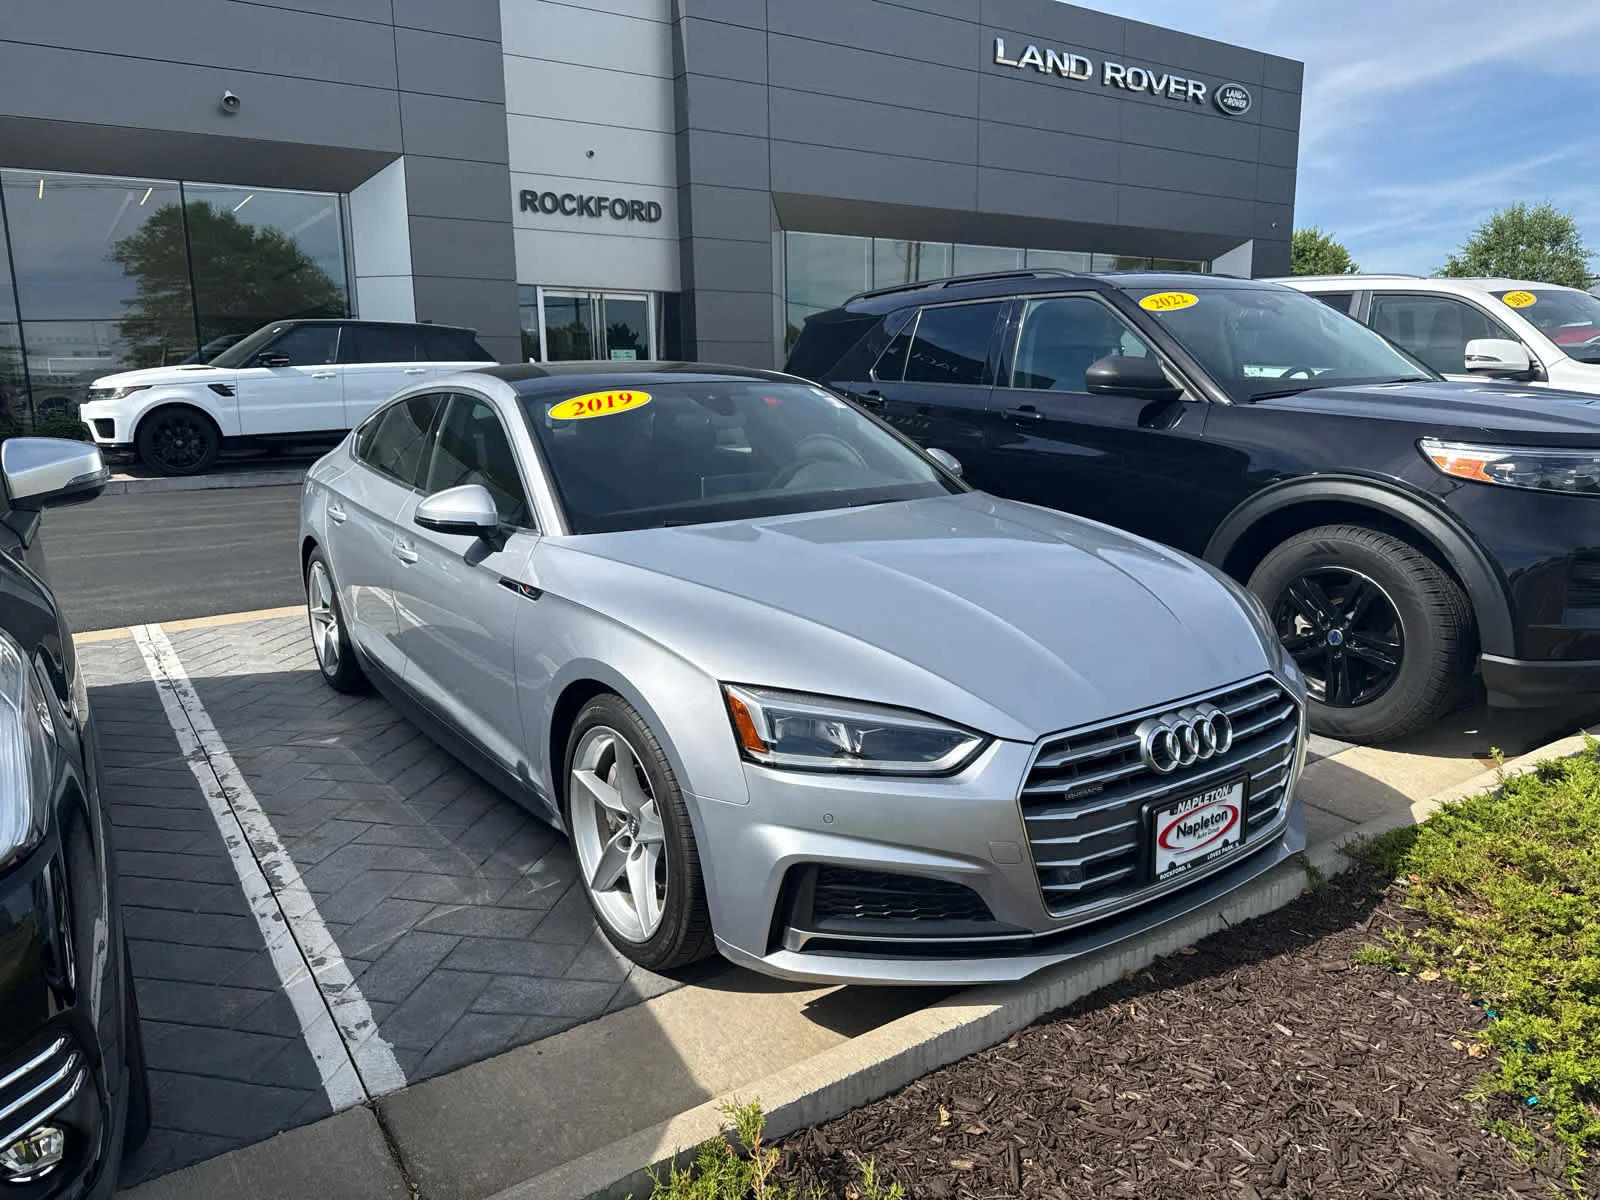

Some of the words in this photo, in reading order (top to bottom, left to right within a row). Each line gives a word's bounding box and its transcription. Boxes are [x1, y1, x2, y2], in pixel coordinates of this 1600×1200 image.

[994, 38, 1093, 81] LAND
[1102, 61, 1208, 104] ROVER
[1226, 89, 1243, 98] LAND
[1227, 97, 1247, 108] ROVER
[519, 189, 662, 223] ROCKFORD
[1151, 294, 1189, 309] 2022
[572, 392, 633, 416] 2019
[1177, 785, 1230, 814] NAPLETON
[1176, 810, 1228, 839] Napleton
